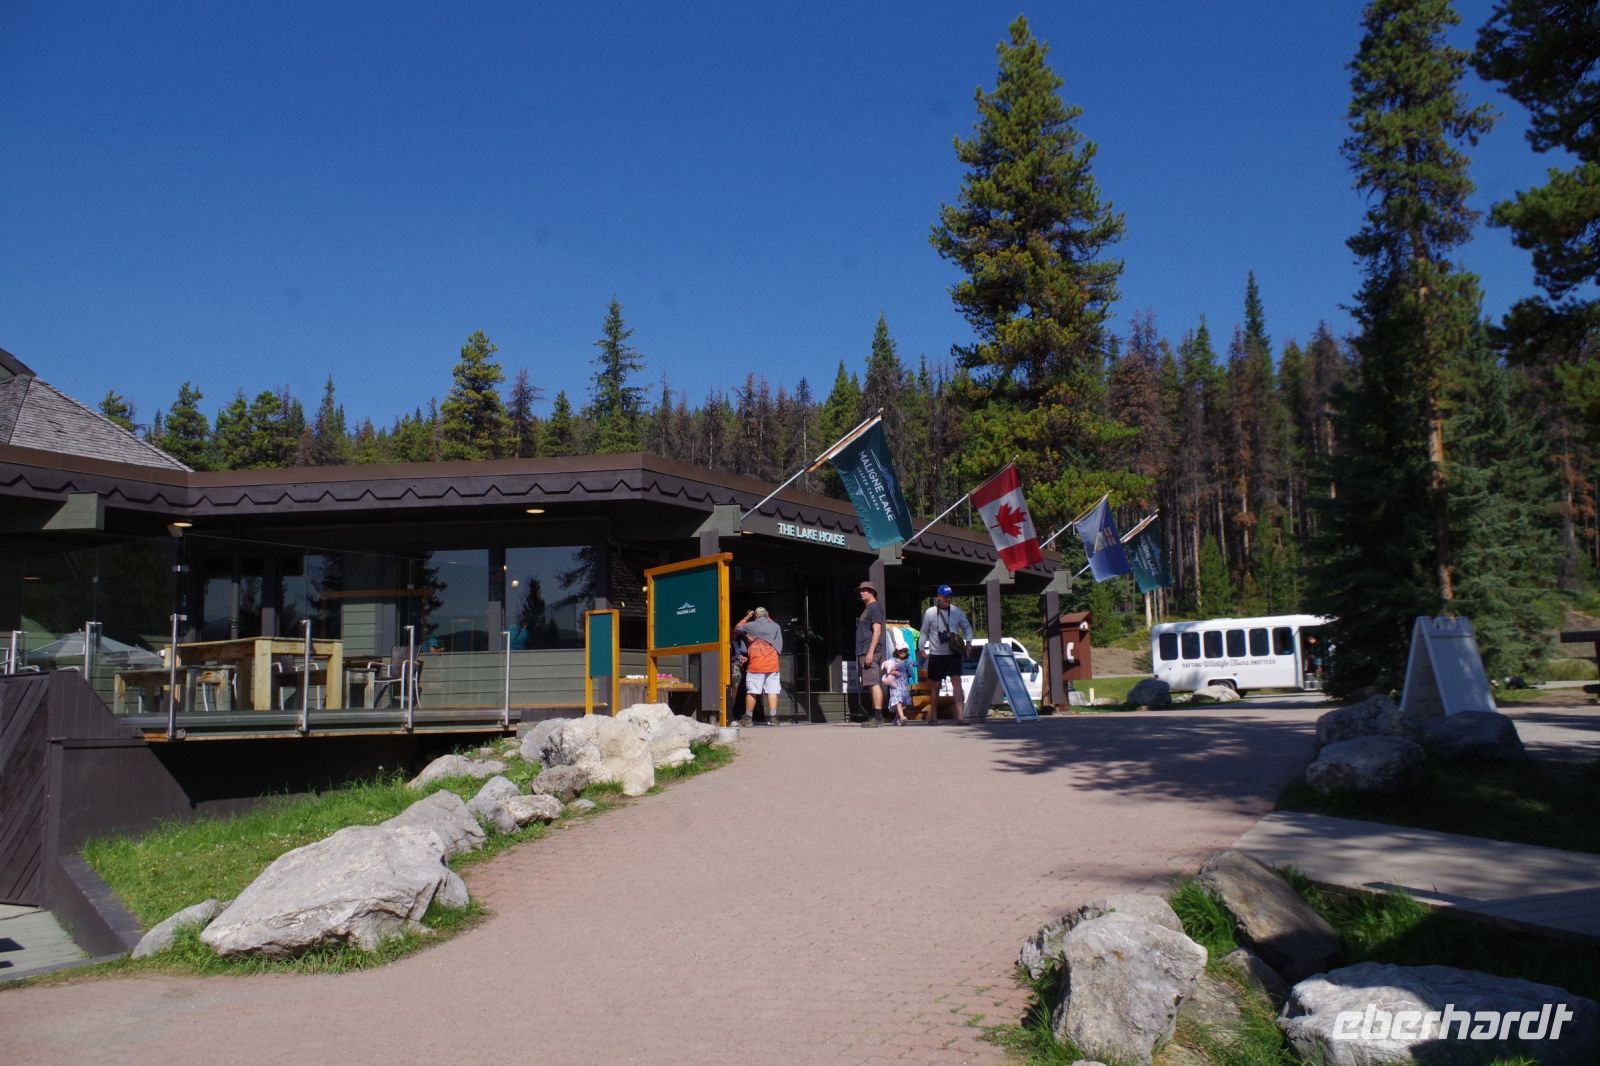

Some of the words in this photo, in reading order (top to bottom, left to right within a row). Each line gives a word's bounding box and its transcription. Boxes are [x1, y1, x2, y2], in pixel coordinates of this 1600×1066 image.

[858, 450, 885, 493] MALIGNE
[878, 494, 896, 522] LAKE
[867, 487, 881, 511] CANADA
[777, 522, 795, 537] THE
[796, 526, 818, 541] LAKE
[819, 530, 846, 546] HOUSE
